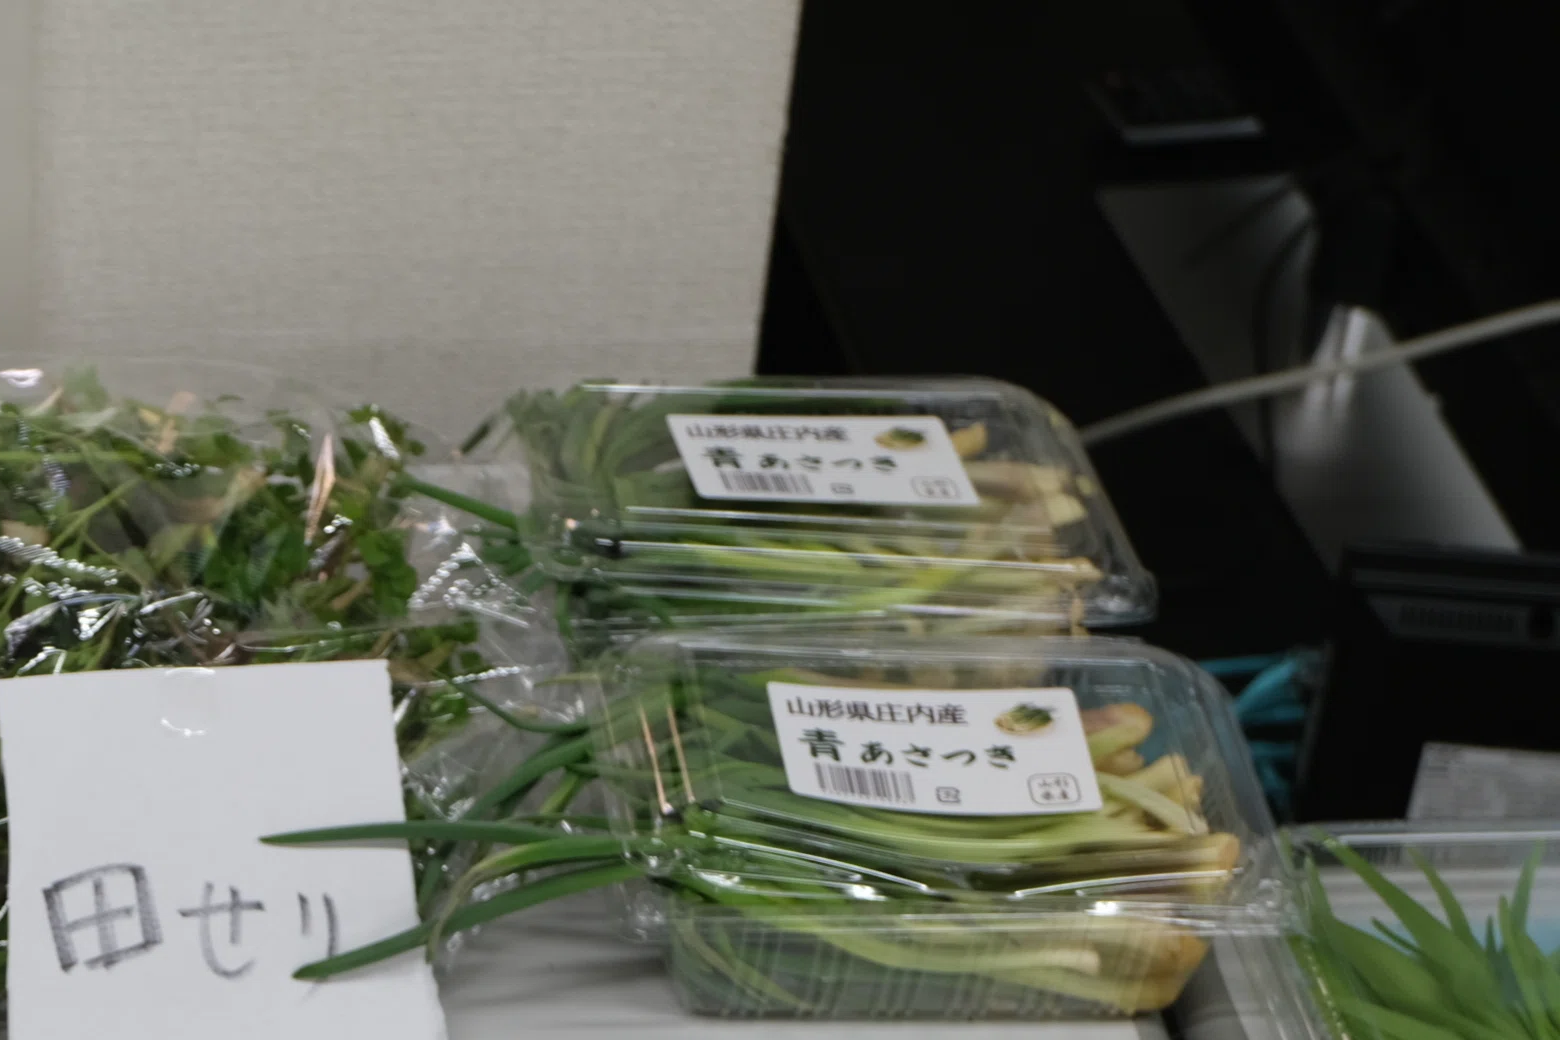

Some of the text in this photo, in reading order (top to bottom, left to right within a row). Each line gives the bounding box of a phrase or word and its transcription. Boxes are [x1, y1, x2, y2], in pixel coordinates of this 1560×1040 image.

[701, 446, 898, 472] 青あさつき
[786, 696, 969, 726] 山形県庄内産
[798, 728, 1016, 769] 青あさつき
[42, 862, 340, 1006] 田せり
